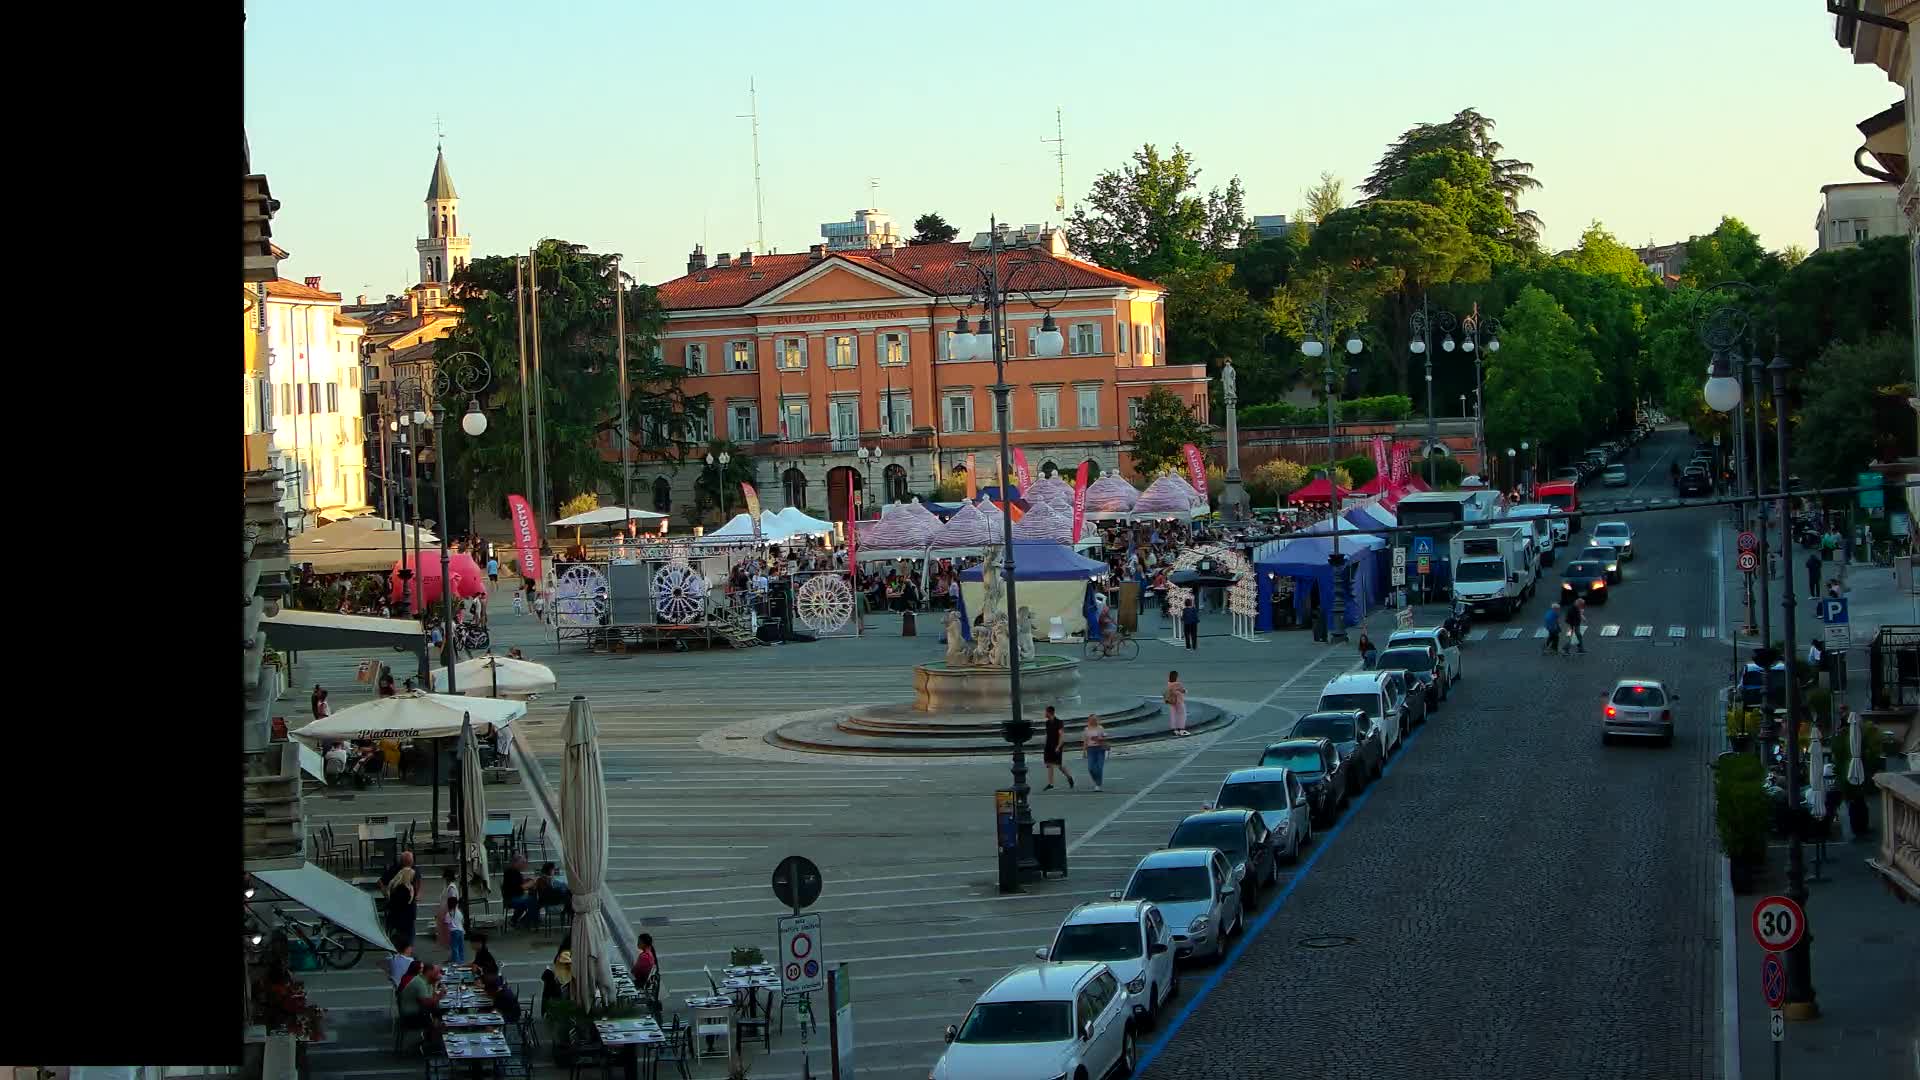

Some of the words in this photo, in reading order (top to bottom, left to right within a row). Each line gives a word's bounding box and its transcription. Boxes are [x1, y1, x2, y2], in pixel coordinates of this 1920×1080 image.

[1742, 557, 1753, 567] 20
[1827, 601, 1842, 621] P
[358, 728, 420, 739] Piadineria
[1762, 911, 1792, 937] 30
